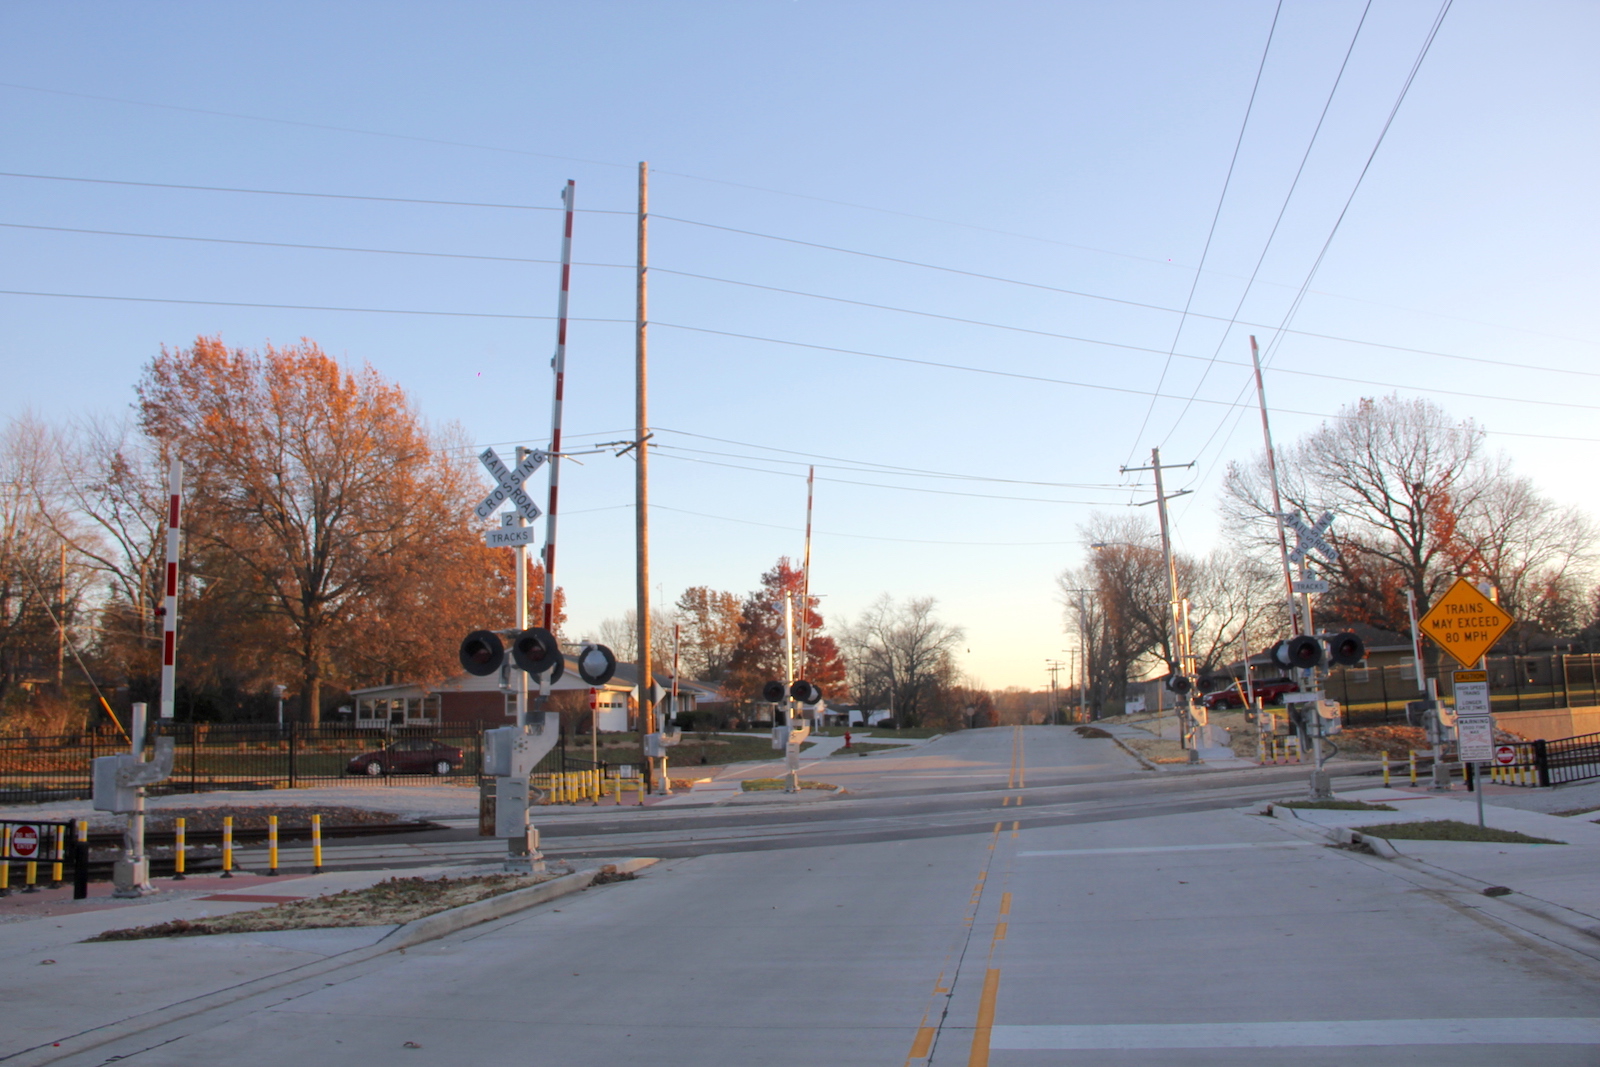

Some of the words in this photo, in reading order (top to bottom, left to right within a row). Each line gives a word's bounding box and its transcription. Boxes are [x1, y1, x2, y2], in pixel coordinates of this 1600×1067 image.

[477, 452, 543, 517] CROSSING
[482, 450, 538, 519] RAILROAD
[505, 515, 513, 526] 2
[492, 531, 528, 543] TRACKS
[1286, 515, 1336, 560] RAILROAD
[1290, 513, 1332, 562] CROSSING
[1306, 571, 1313, 579] 2
[1445, 603, 1484, 614] TRAINS
[1432, 619, 1453, 629] MAY
[1458, 616, 1499, 628] EXCEED
[1445, 632, 1460, 643] 80
[1464, 631, 1488, 642] MPH
[1455, 672, 1485, 680] CAUTION
